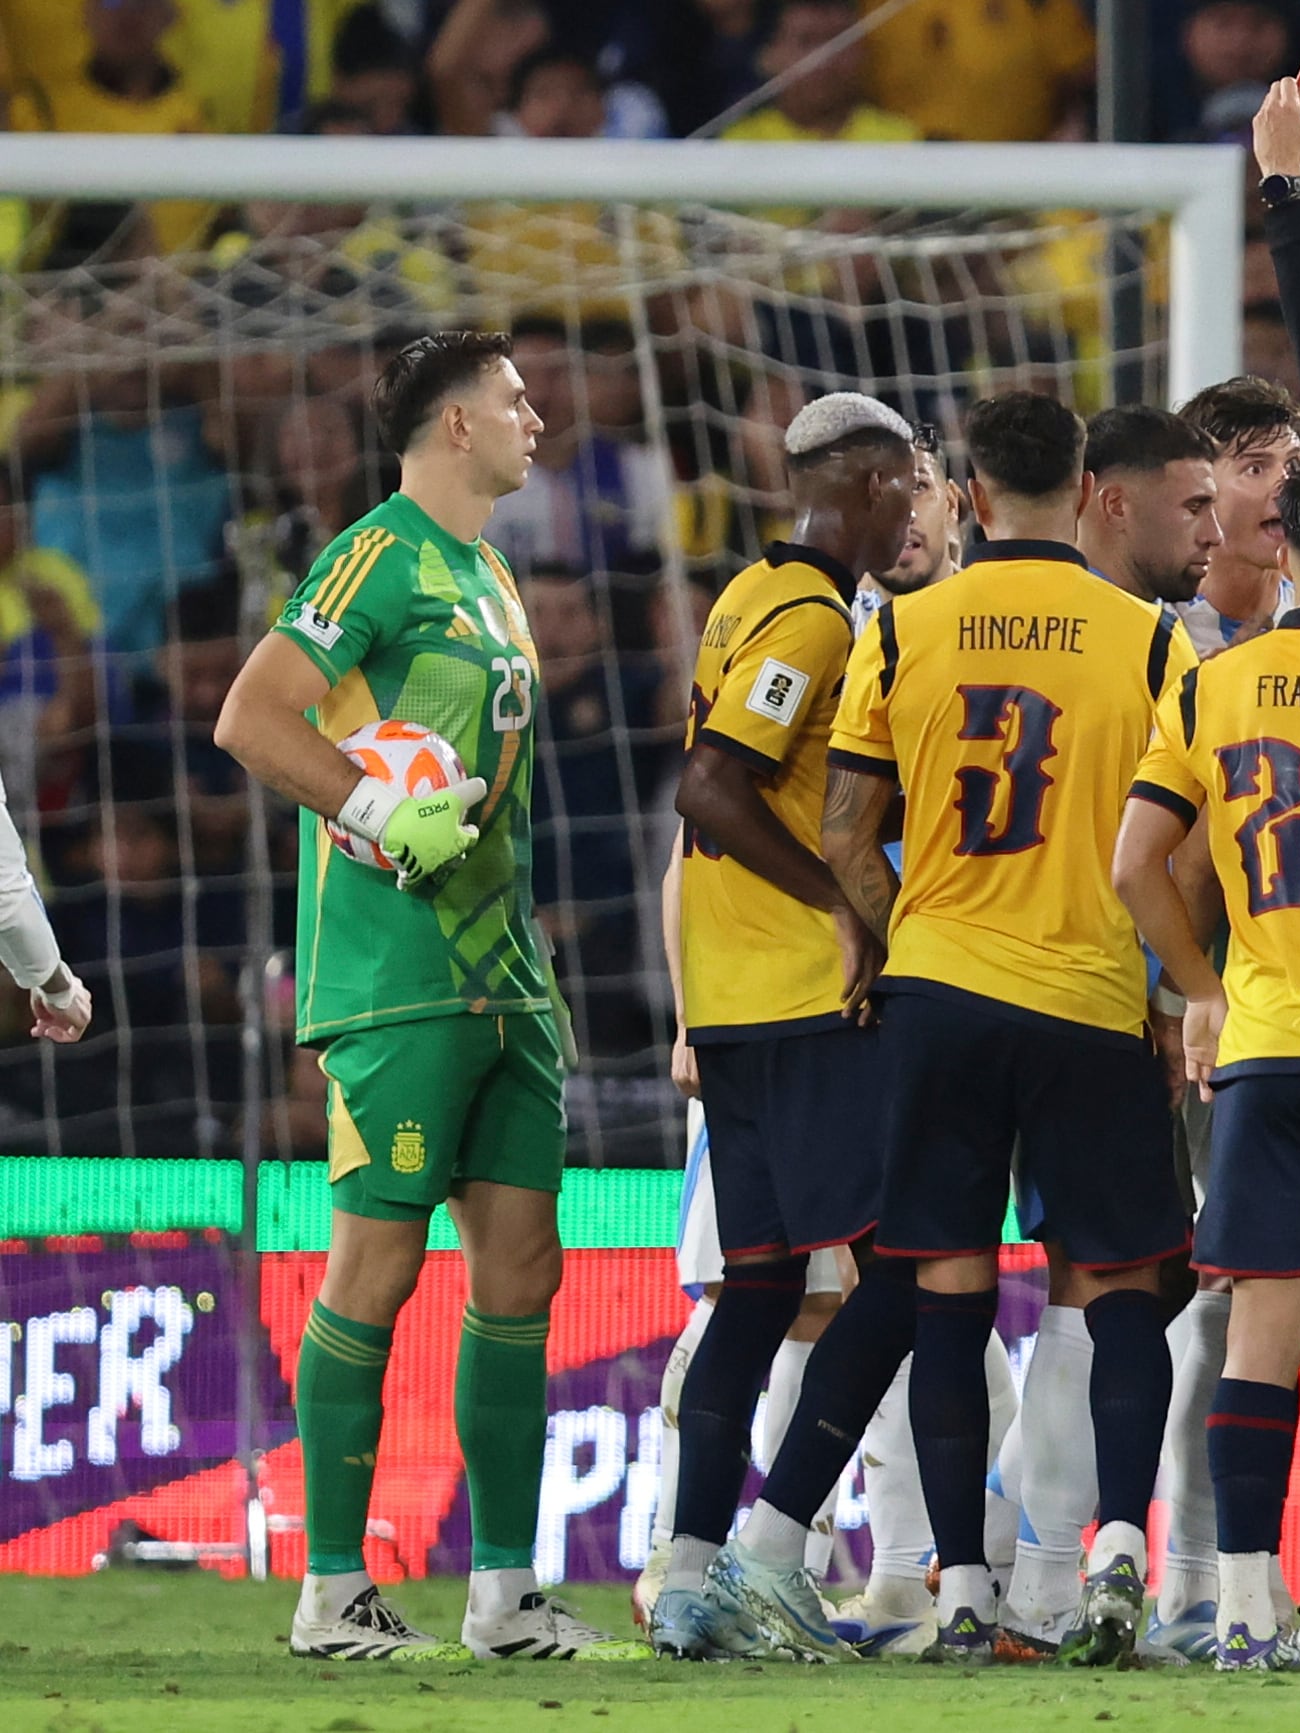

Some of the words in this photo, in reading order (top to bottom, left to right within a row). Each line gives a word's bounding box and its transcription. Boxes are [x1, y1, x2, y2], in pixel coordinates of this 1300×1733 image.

[957, 615, 1088, 654] HINCAPIE
[491, 655, 532, 732] 23
[953, 684, 1063, 857] 3
[417, 800, 450, 818] PRED
